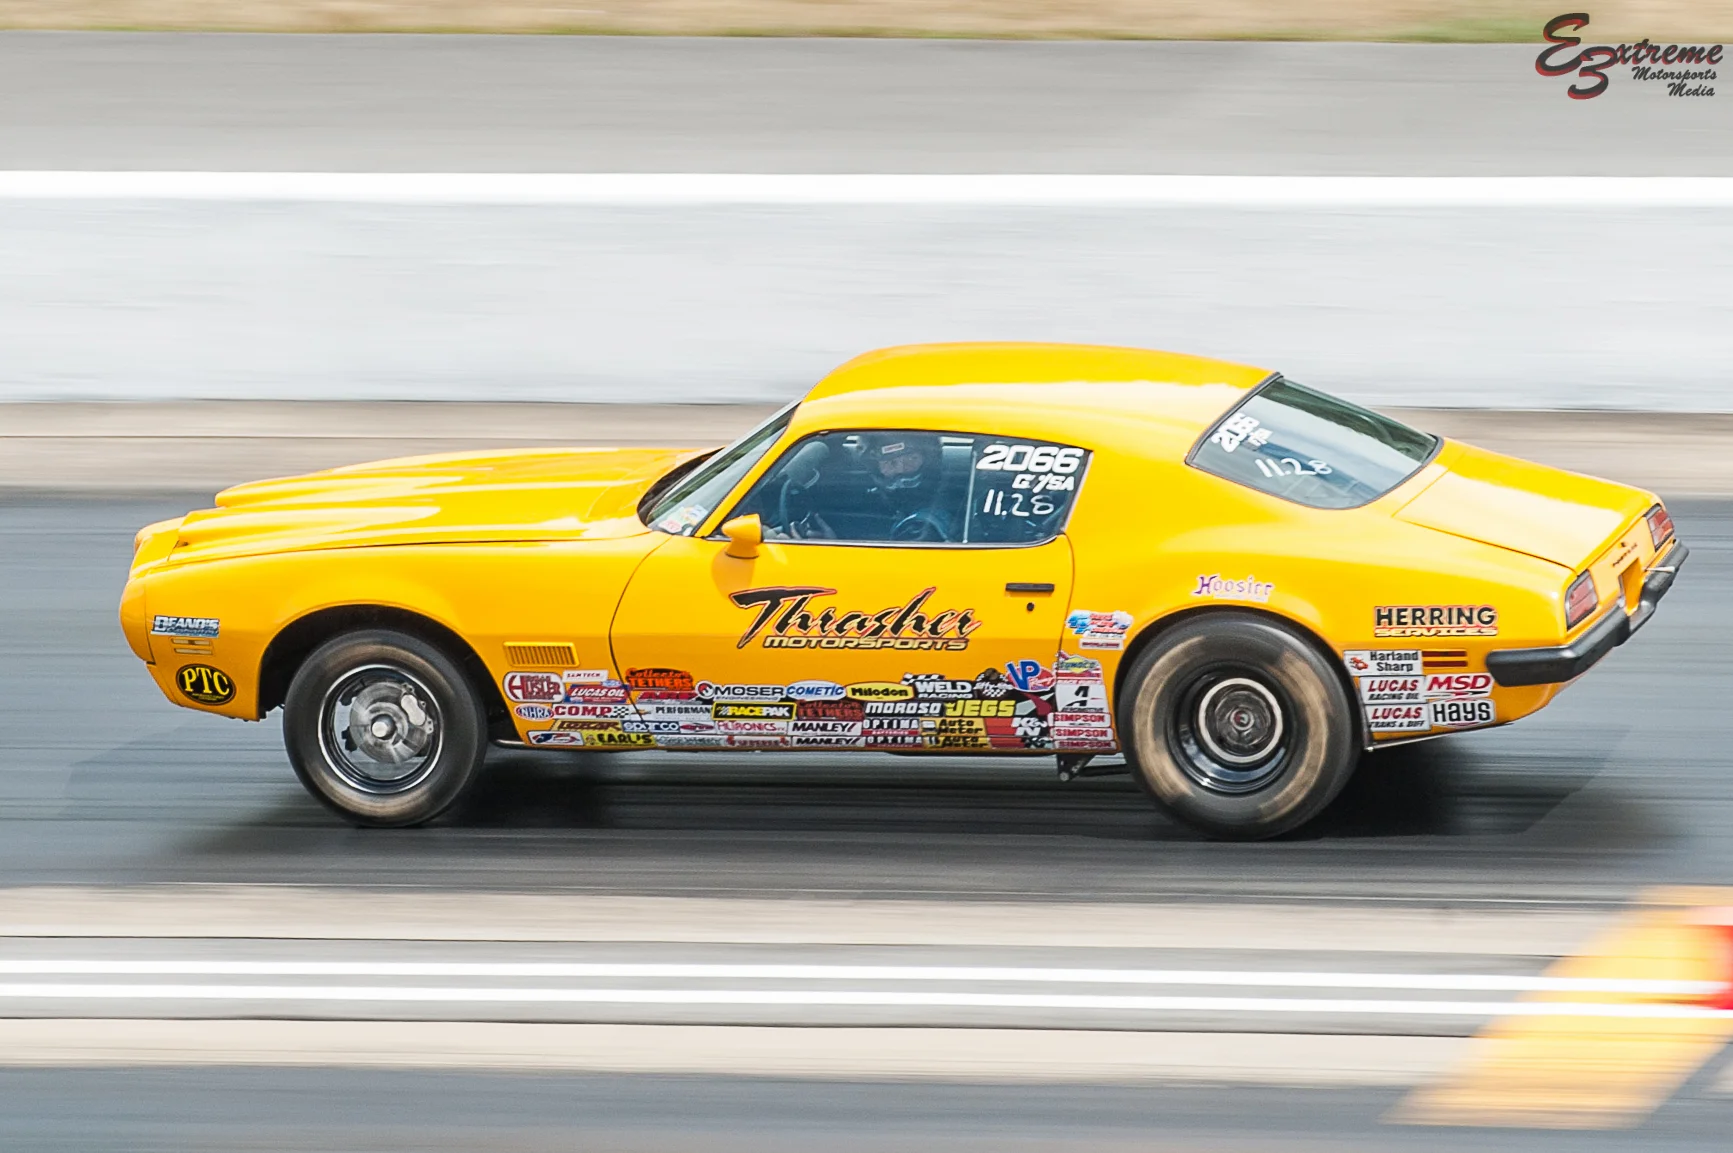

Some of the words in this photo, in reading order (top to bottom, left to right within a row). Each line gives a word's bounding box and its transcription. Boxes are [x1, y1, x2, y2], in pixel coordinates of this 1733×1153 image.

[976, 444, 1084, 473] 2066
[1255, 458, 1333, 478] 11.28
[983, 489, 1055, 517] 11.28
[729, 586, 983, 650] Thrasher
[1375, 606, 1497, 627] HERRING
[1375, 627, 1498, 637] SERVICES
[763, 635, 970, 651] MOTORSPORTS
[1369, 650, 1419, 662] Harland
[1376, 661, 1414, 673] Sharp
[182, 666, 230, 696] PTC
[1006, 660, 1040, 691] VP
[628, 677, 691, 688] TETHERS
[915, 681, 972, 692] WELD
[1367, 679, 1420, 692] LUCAS
[1427, 674, 1492, 692] MSD
[570, 688, 607, 697] LUCAS
[607, 688, 625, 697] OIL
[714, 686, 785, 696] MOSER
[786, 685, 846, 696] COMETIC
[851, 686, 910, 697] Milodon
[1368, 693, 1404, 701] RACING
[1405, 692, 1420, 700] OIL
[520, 706, 551, 718] NHRA
[554, 705, 612, 717] COMP
[864, 702, 943, 713] MOROSO
[944, 700, 1016, 718] JEGS
[1371, 707, 1423, 720] LUCAS
[1432, 701, 1491, 723] Hays
[863, 719, 920, 729] OPTIMA
[939, 719, 974, 727] Auto
[1054, 714, 1105, 722] SIMPSON
[791, 723, 849, 732] MANLEY
[938, 727, 983, 735] Meter
[1055, 728, 1108, 737] SIMPSON
[598, 732, 653, 744] EARL'S
[796, 737, 853, 745] MANLEY
[867, 736, 922, 744] OPTIMA
